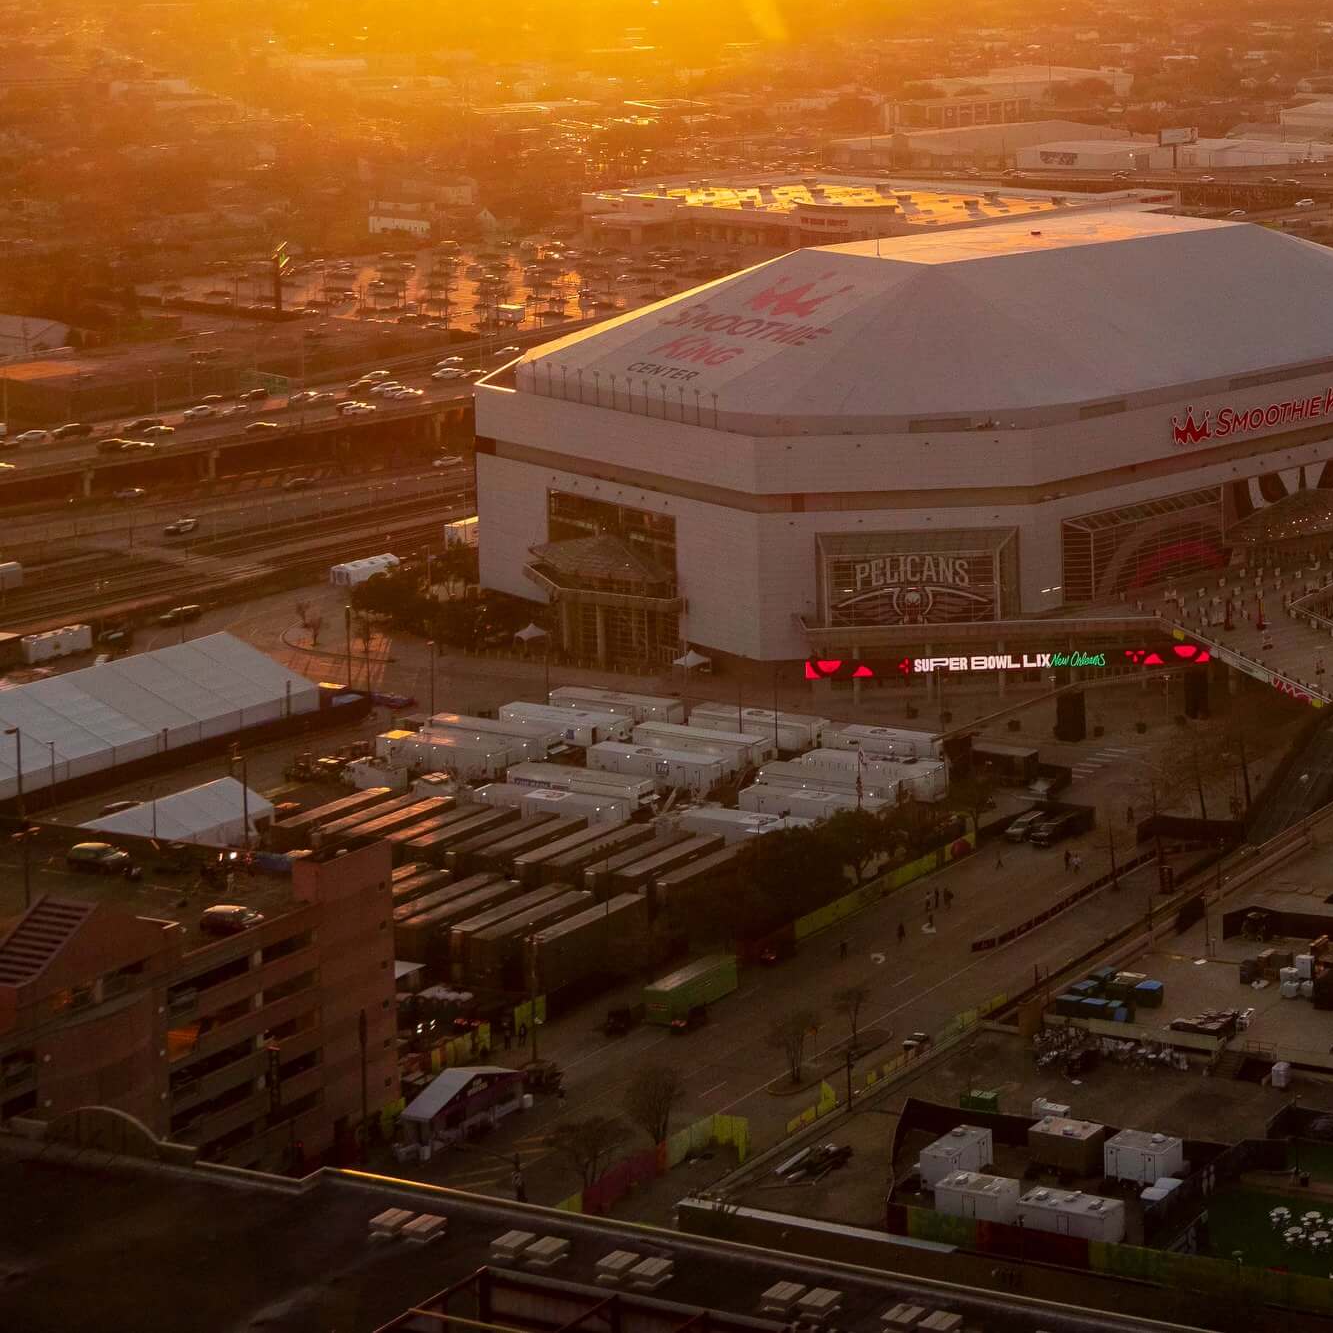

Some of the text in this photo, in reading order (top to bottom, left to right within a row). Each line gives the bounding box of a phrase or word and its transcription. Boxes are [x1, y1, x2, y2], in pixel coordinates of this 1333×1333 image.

[660, 305, 832, 346] SMOOTHIE
[627, 362, 699, 381] CENTER
[1215, 396, 1322, 436] SMOOTHIE
[854, 555, 970, 588] PELICANS
[914, 658, 967, 673] SUPER
[971, 656, 1020, 670] BOWL
[1023, 654, 1051, 669] LIX
[1052, 653, 1070, 668] New
